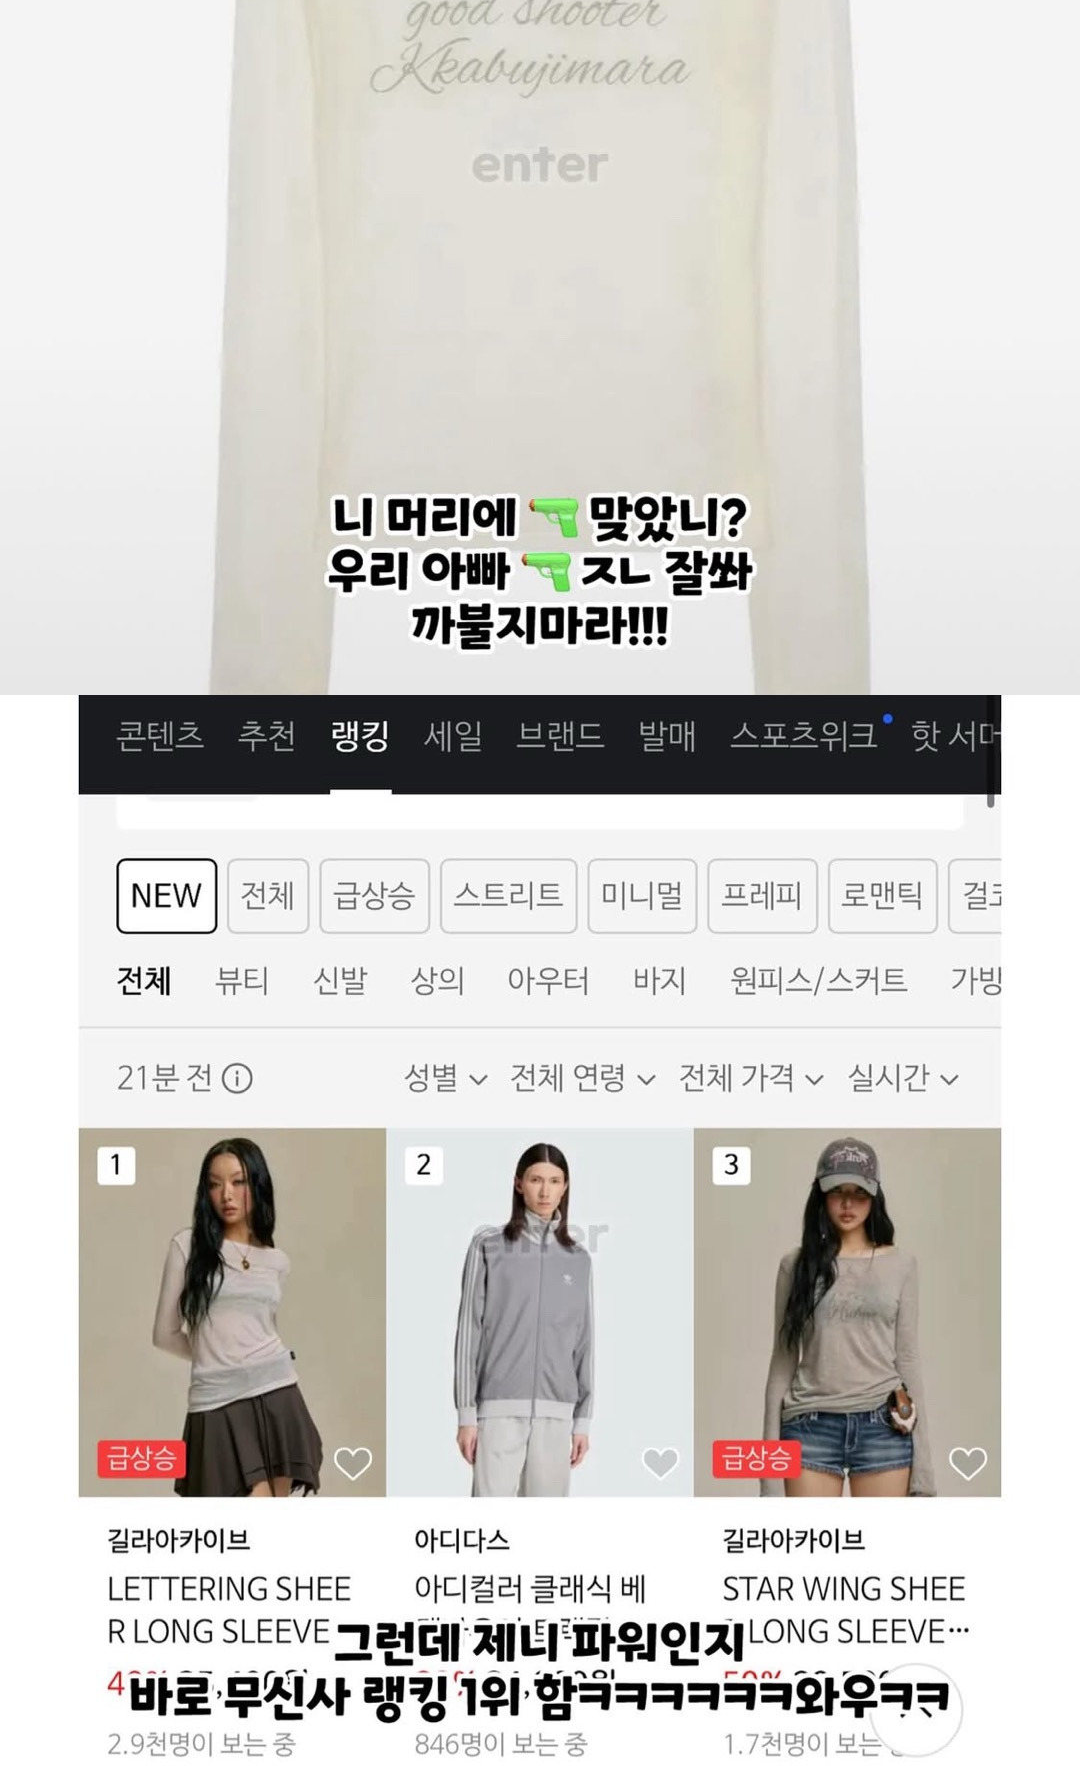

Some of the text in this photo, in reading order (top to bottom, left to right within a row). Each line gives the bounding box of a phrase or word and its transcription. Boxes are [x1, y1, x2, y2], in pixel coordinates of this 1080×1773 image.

[369, 37, 692, 98] Kkabujimara
[116, 720, 205, 752] 콘텐츠
[238, 720, 295, 753] 추천
[331, 720, 389, 753] 랭킹
[423, 720, 482, 753] 세일
[516, 720, 605, 752] 브랜드
[639, 720, 695, 753] 발매
[730, 720, 878, 753] 스포츠위크
[911, 720, 942, 753] 핫
[131, 882, 202, 909] NEW
[241, 881, 294, 911] 전체
[333, 881, 416, 911] 급상승
[453, 880, 564, 911] 스트리트
[602, 880, 682, 911] 미니멀
[721, 880, 801, 911] 프레피
[841, 881, 923, 911] 로맨틱
[116, 965, 171, 997] 전체
[215, 966, 268, 996] 뷰티
[313, 966, 369, 996] 신발
[410, 966, 463, 996] 상의
[508, 966, 589, 996] 아우터
[634, 965, 686, 996] 바지
[730, 965, 909, 997] 원피스/스커트
[117, 1063, 212, 1093] 21분 전
[404, 1063, 457, 1093] 성별
[510, 1063, 625, 1093] 전체 연령
[679, 1063, 793, 1093] 전체 가격
[848, 1063, 931, 1093] 실시간
[110, 1153, 121, 1176] 1
[416, 1153, 431, 1176] 2
[724, 1153, 739, 1176] 3
[107, 1445, 177, 1471] 급상승
[722, 1445, 792, 1471] 급상승
[107, 1527, 251, 1555] 길라아카이브
[414, 1527, 511, 1555] 아디다스
[723, 1527, 866, 1555] 길라아카이브
[108, 1575, 352, 1602] LETTERING SHEE
[415, 1573, 646, 1605] 아디컬러 클래식 베
[723, 1575, 966, 1602] STAR WING SHEE
[108, 1618, 330, 1644] R LONG SLEEVE
[749, 1618, 829, 1644] LONG
[107, 1731, 297, 1758] 2.9천명이 보는 중
[415, 1731, 589, 1758] 846명이 보는 중
[724, 1731, 884, 1758] 1.7천명이 보는
